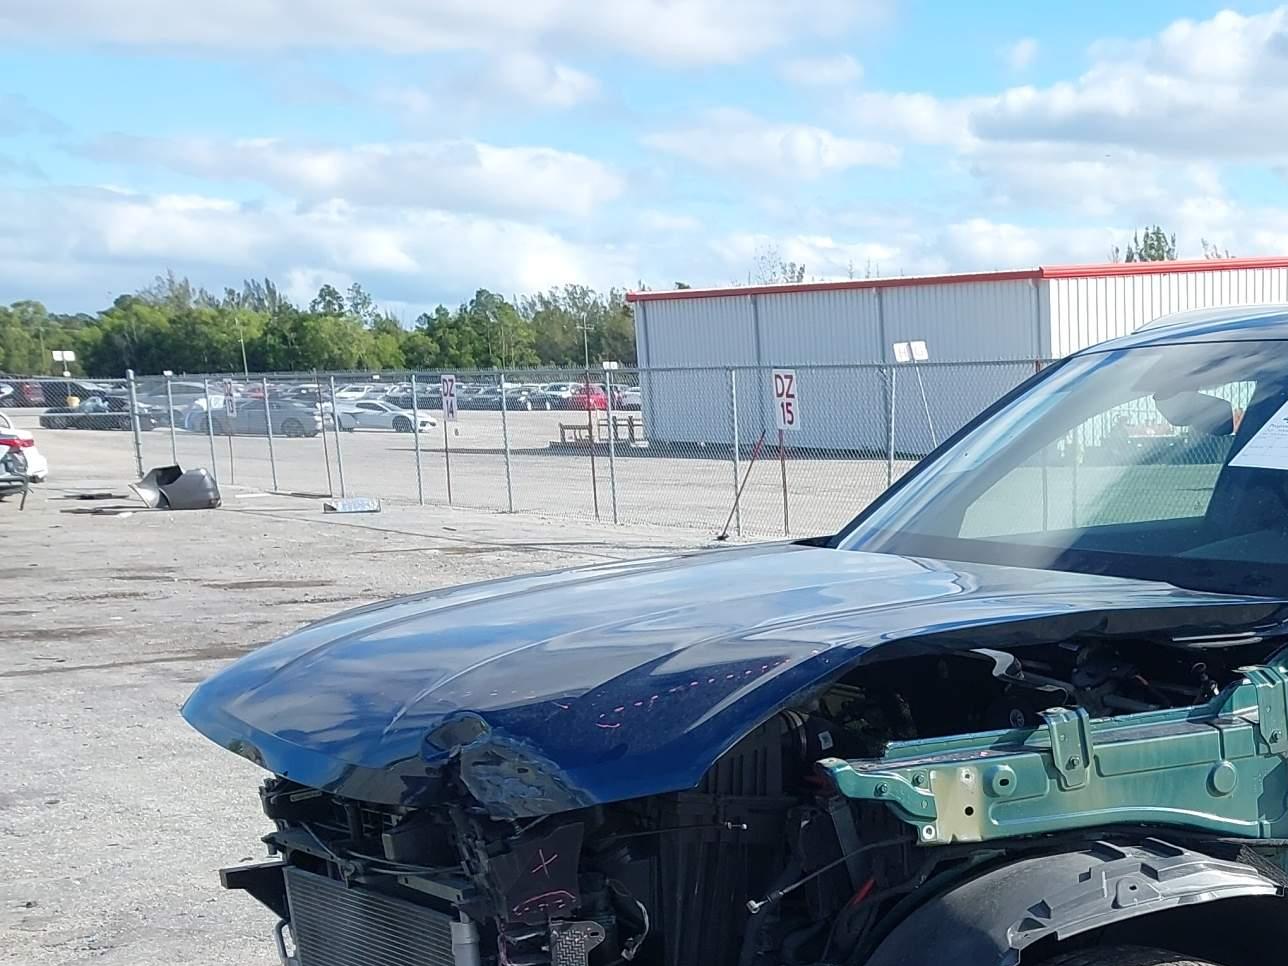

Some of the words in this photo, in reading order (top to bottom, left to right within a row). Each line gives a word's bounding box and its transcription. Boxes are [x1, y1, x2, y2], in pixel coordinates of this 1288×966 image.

[443, 379, 455, 398] DZ
[774, 374, 795, 399] DZ
[780, 402, 794, 426] 15
